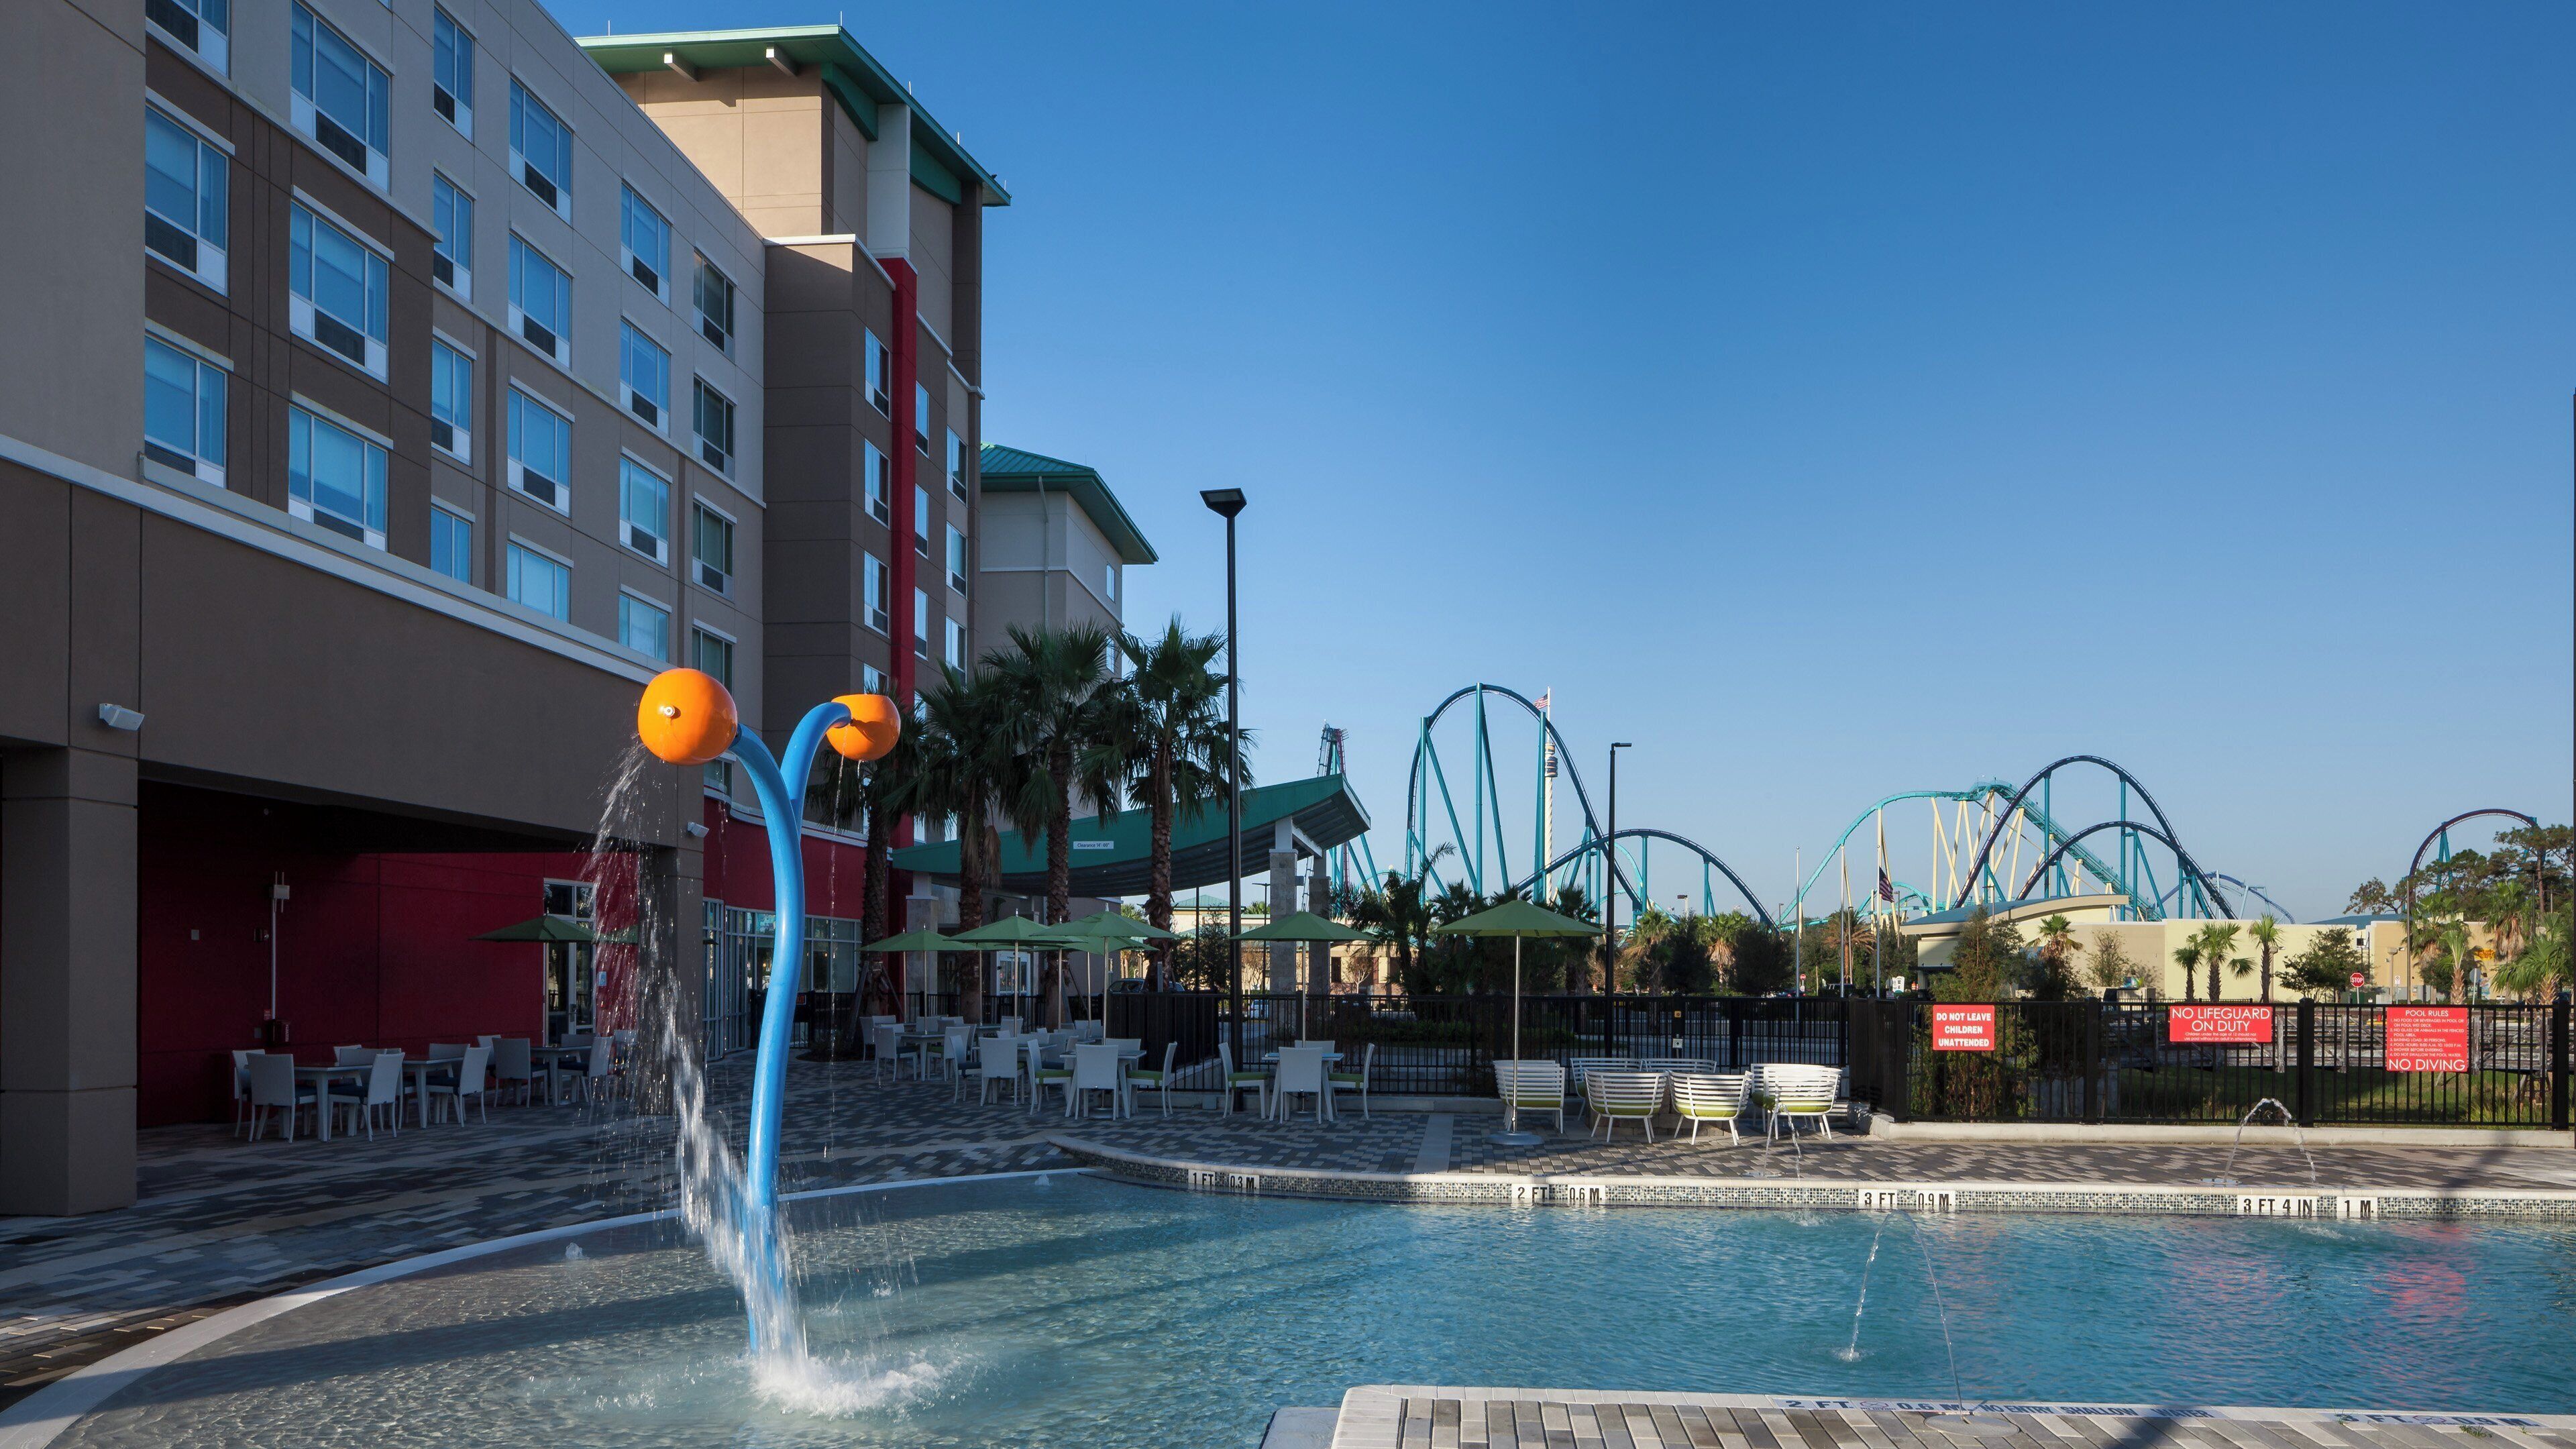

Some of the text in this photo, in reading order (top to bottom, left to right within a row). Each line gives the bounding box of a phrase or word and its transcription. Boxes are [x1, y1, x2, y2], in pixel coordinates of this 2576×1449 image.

[1936, 1012, 1992, 1021] DO NOT LEAVE
[2172, 1008, 2270, 1019] NO LIFEGUARD
[1944, 1025, 1983, 1034] CHILDREN
[2192, 1020, 2250, 1032] ON DUTY
[1938, 1038, 1990, 1047] UNATTENDED
[2389, 1059, 2465, 1071] NO DIVING
[1193, 1172, 1214, 1186] 1 FT.
[1230, 1175, 1256, 1189] 0.3 M.
[1517, 1187, 1548, 1199] 2 FT.
[1569, 1187, 1602, 1200] 0.6 M.
[1864, 1193, 1895, 1205] 3 FT.
[1918, 1193, 1952, 1205] 0.9 M.
[2243, 1198, 2315, 1213] 3 FT. 4 IN.
[2344, 1199, 2374, 1213] 1 M.
[1980, 1404, 2215, 1418] NO ENTRY SHALLOW WATER
[2336, 1413, 2414, 1423] 3 FT.
